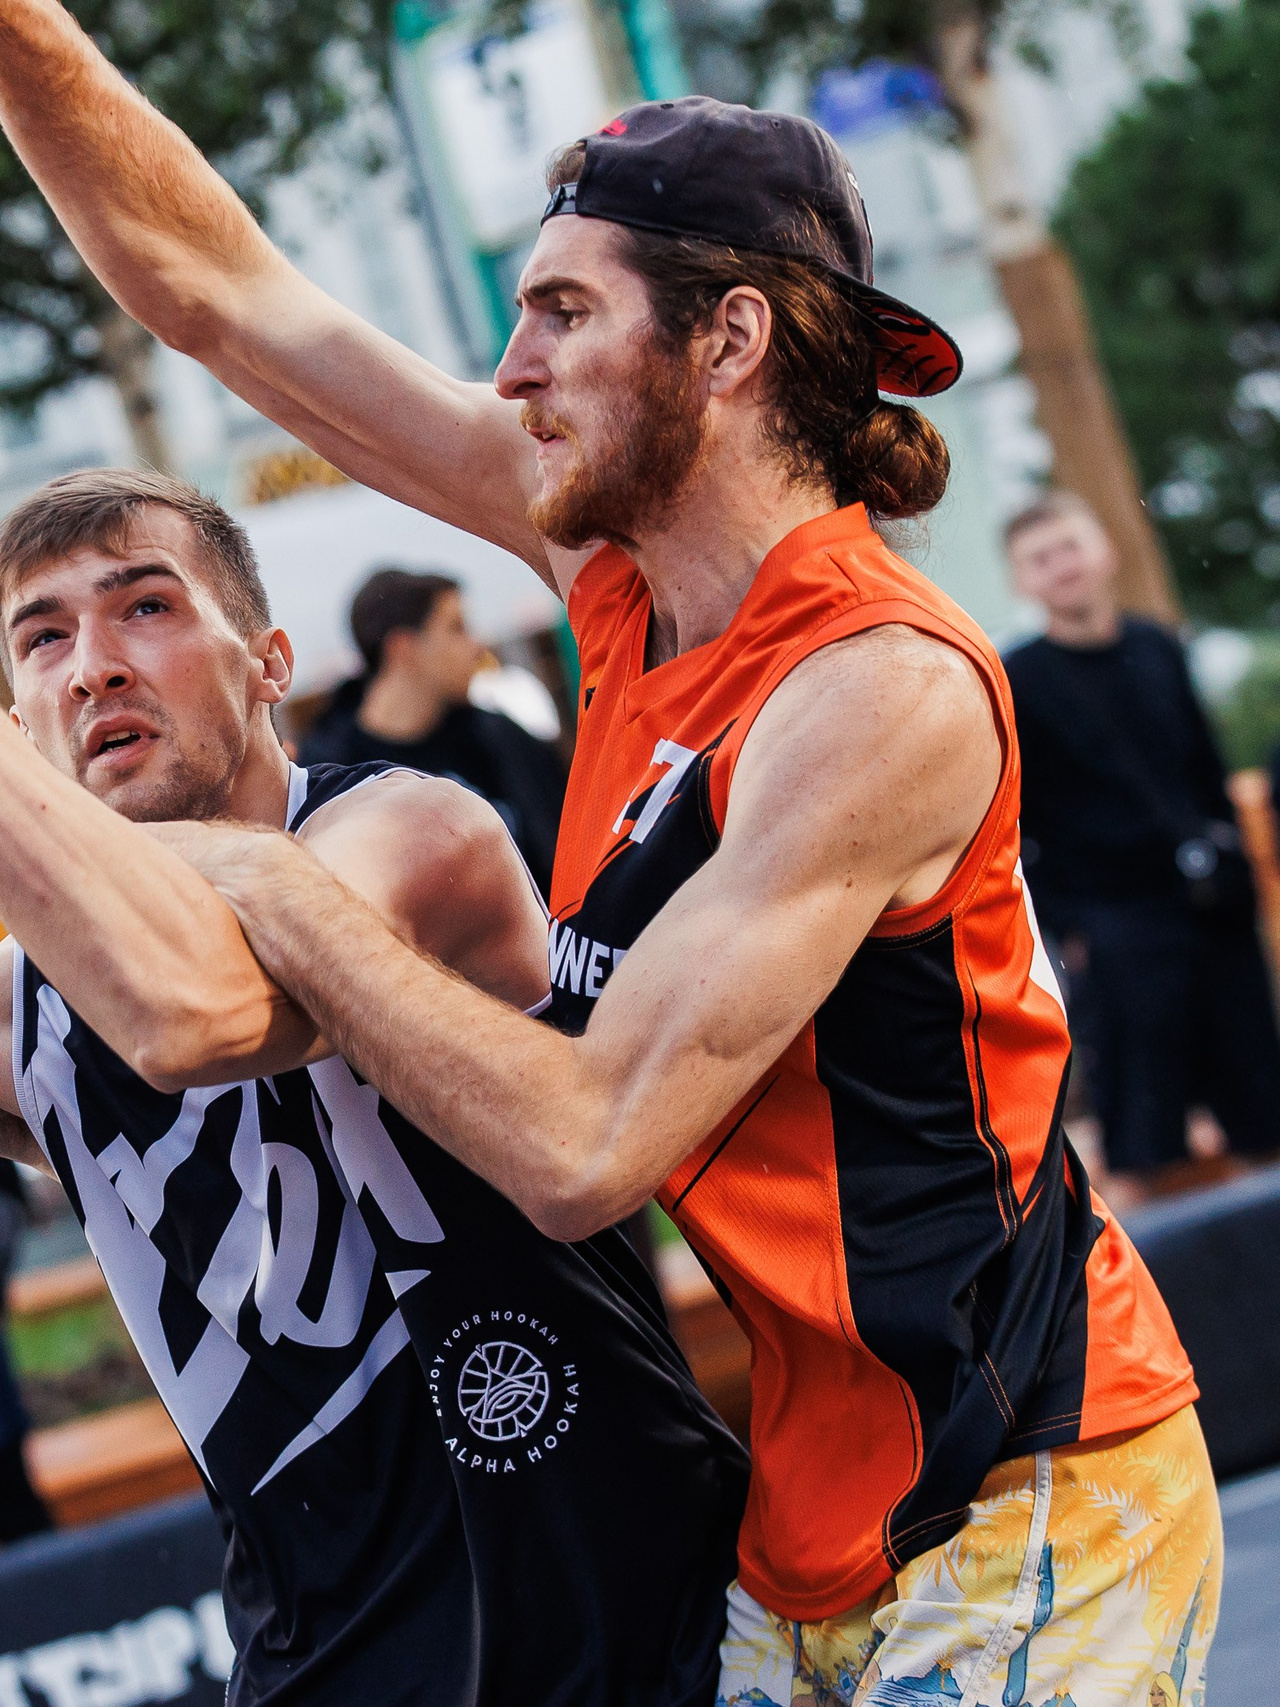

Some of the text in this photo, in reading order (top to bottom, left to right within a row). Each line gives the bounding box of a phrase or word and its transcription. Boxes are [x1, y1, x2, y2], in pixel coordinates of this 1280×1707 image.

[549, 918, 628, 997] NNE
[443, 1314, 481, 1348] YOUR
[490, 1311, 559, 1345] HOOKAH
[445, 1364, 580, 1473] ALPHA HOOKAH
